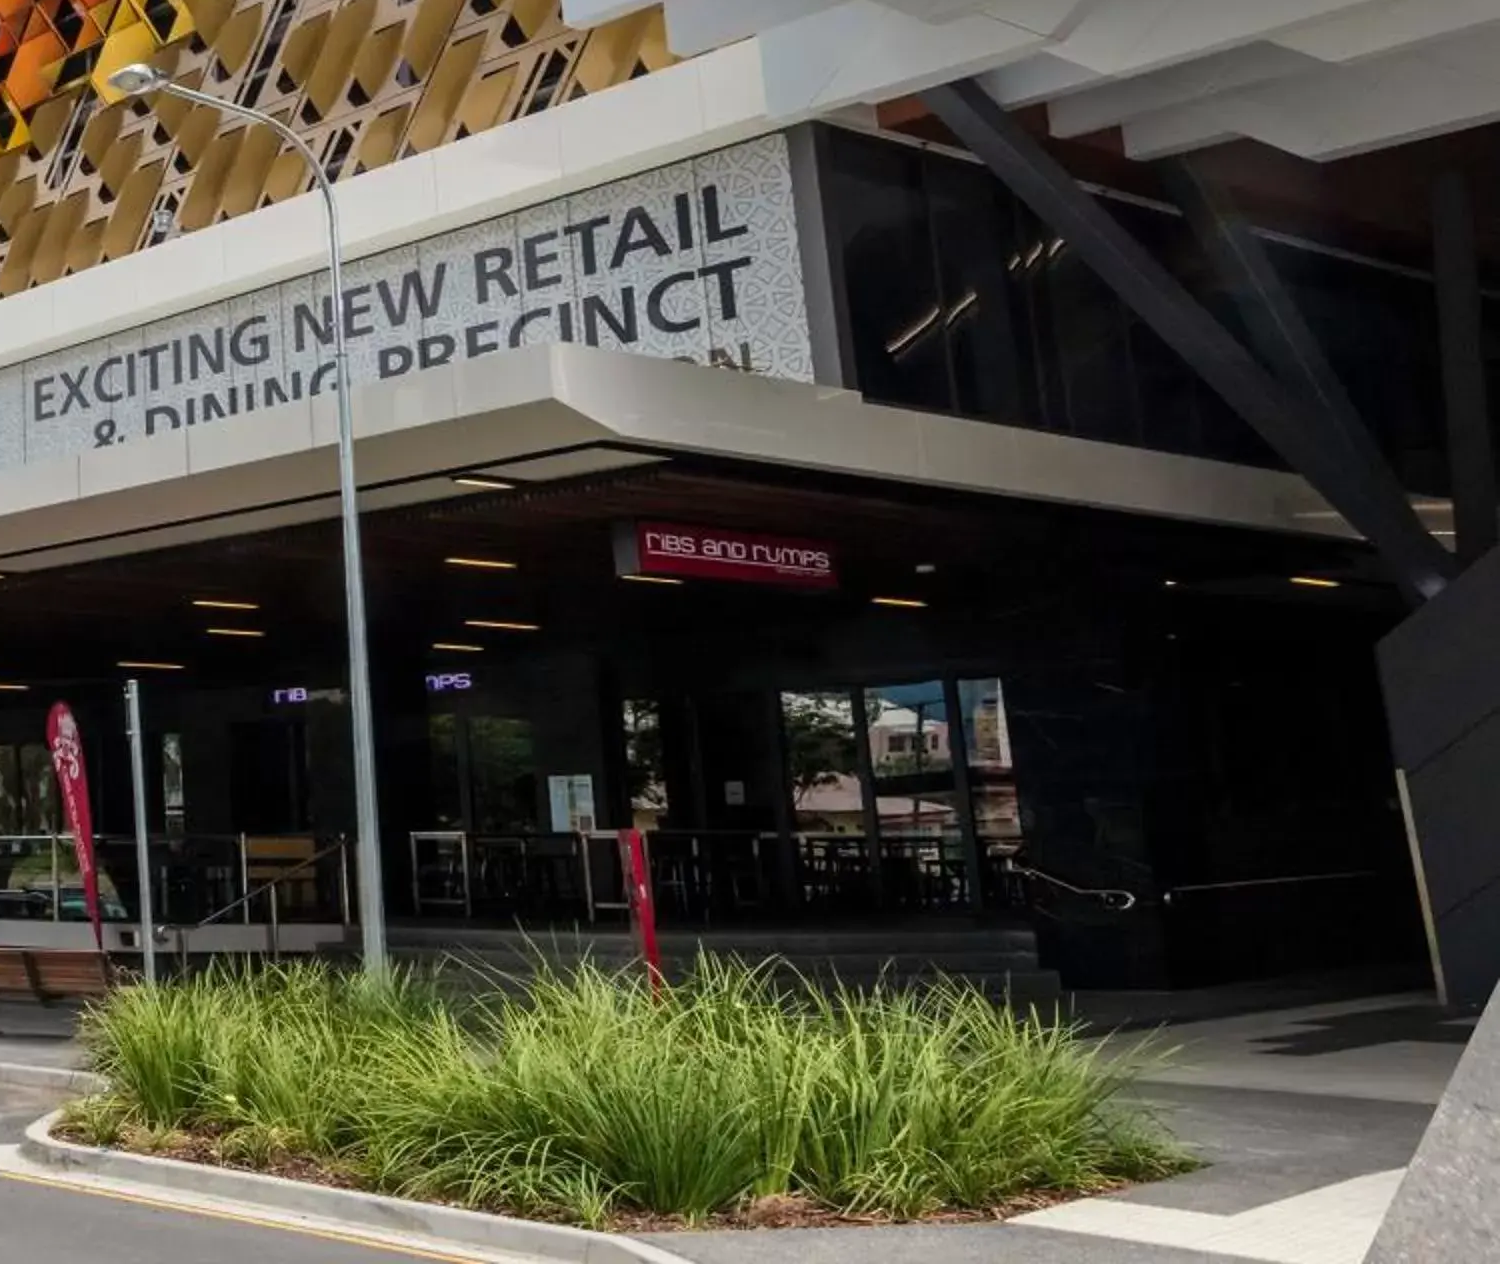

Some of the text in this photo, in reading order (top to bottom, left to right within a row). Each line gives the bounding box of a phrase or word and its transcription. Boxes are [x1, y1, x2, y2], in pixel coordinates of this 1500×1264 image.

[34, 184, 748, 422] EXCITING NEW RETAIL
